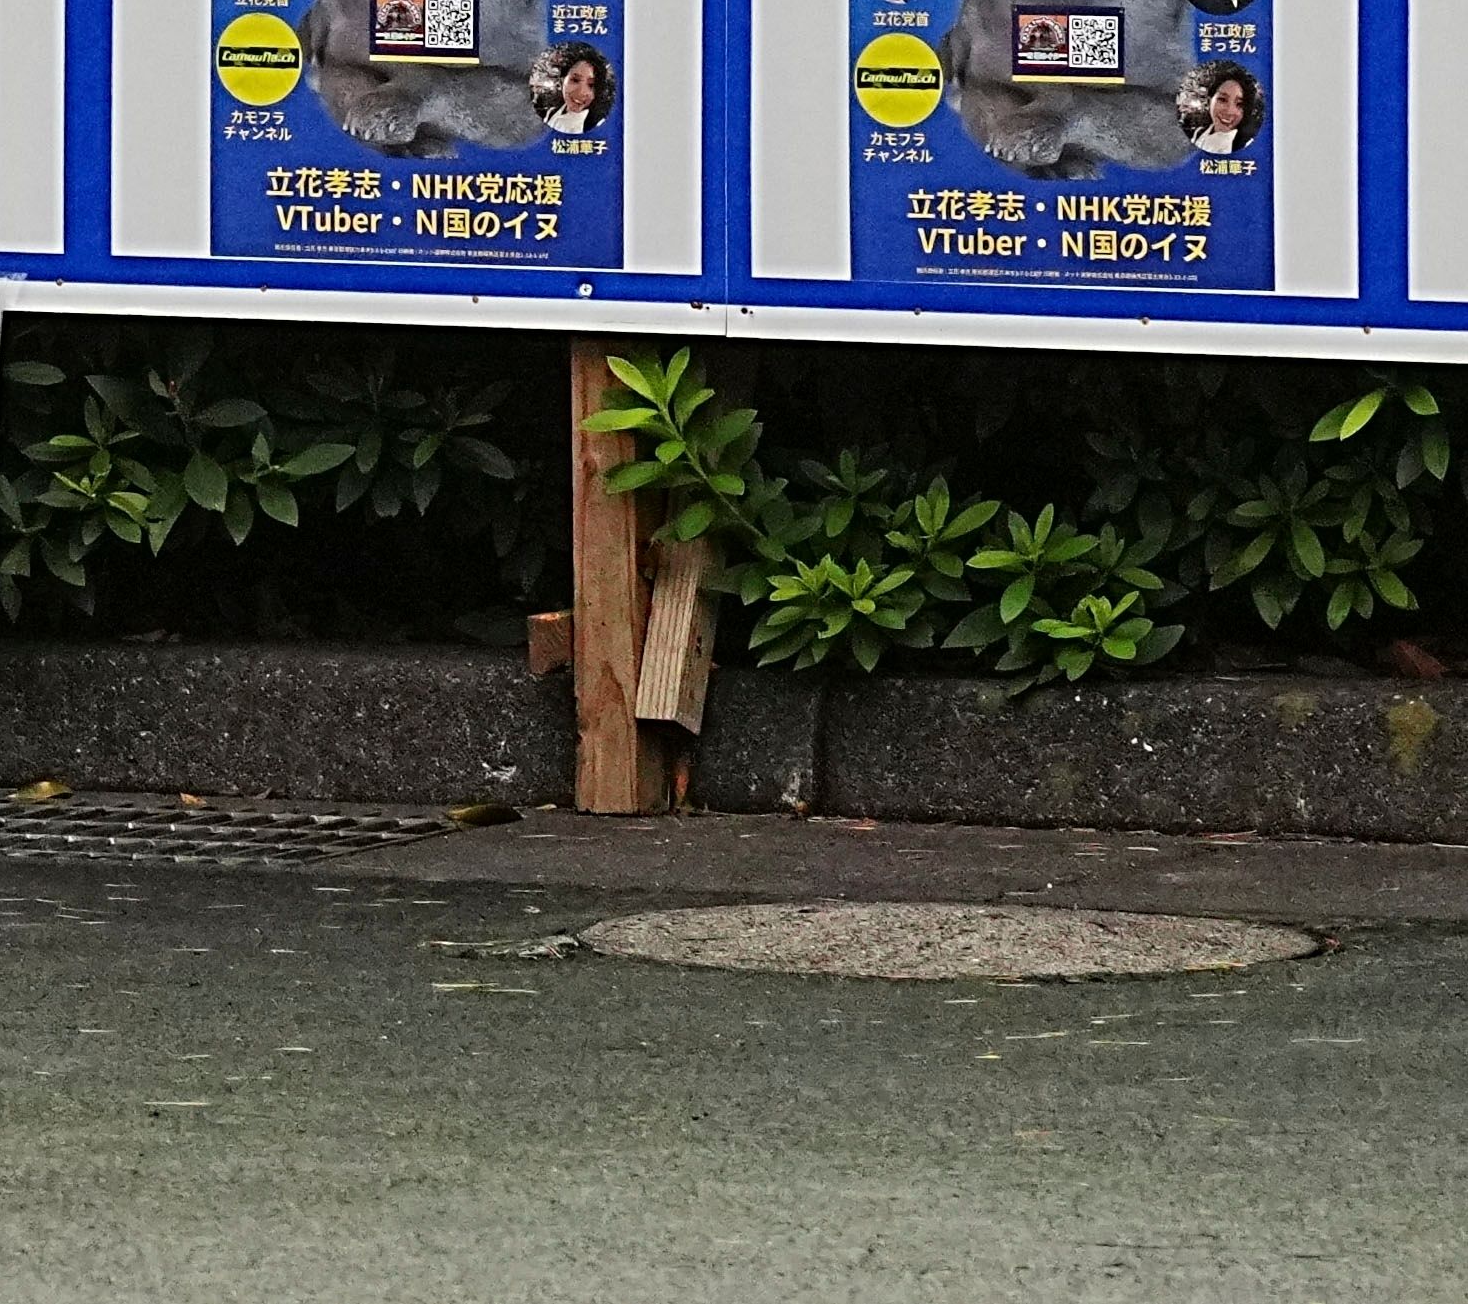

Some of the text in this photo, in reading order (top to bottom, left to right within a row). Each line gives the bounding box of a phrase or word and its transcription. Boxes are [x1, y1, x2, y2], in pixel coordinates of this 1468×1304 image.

[873, 12, 929, 26] 立花党首
[870, 133, 926, 146] カモフラ
[864, 149, 933, 163] チャンネル
[267, 166, 563, 206] 立花孝志・NHK党応援
[908, 189, 1211, 227] 立花孝志・NHK党応援
